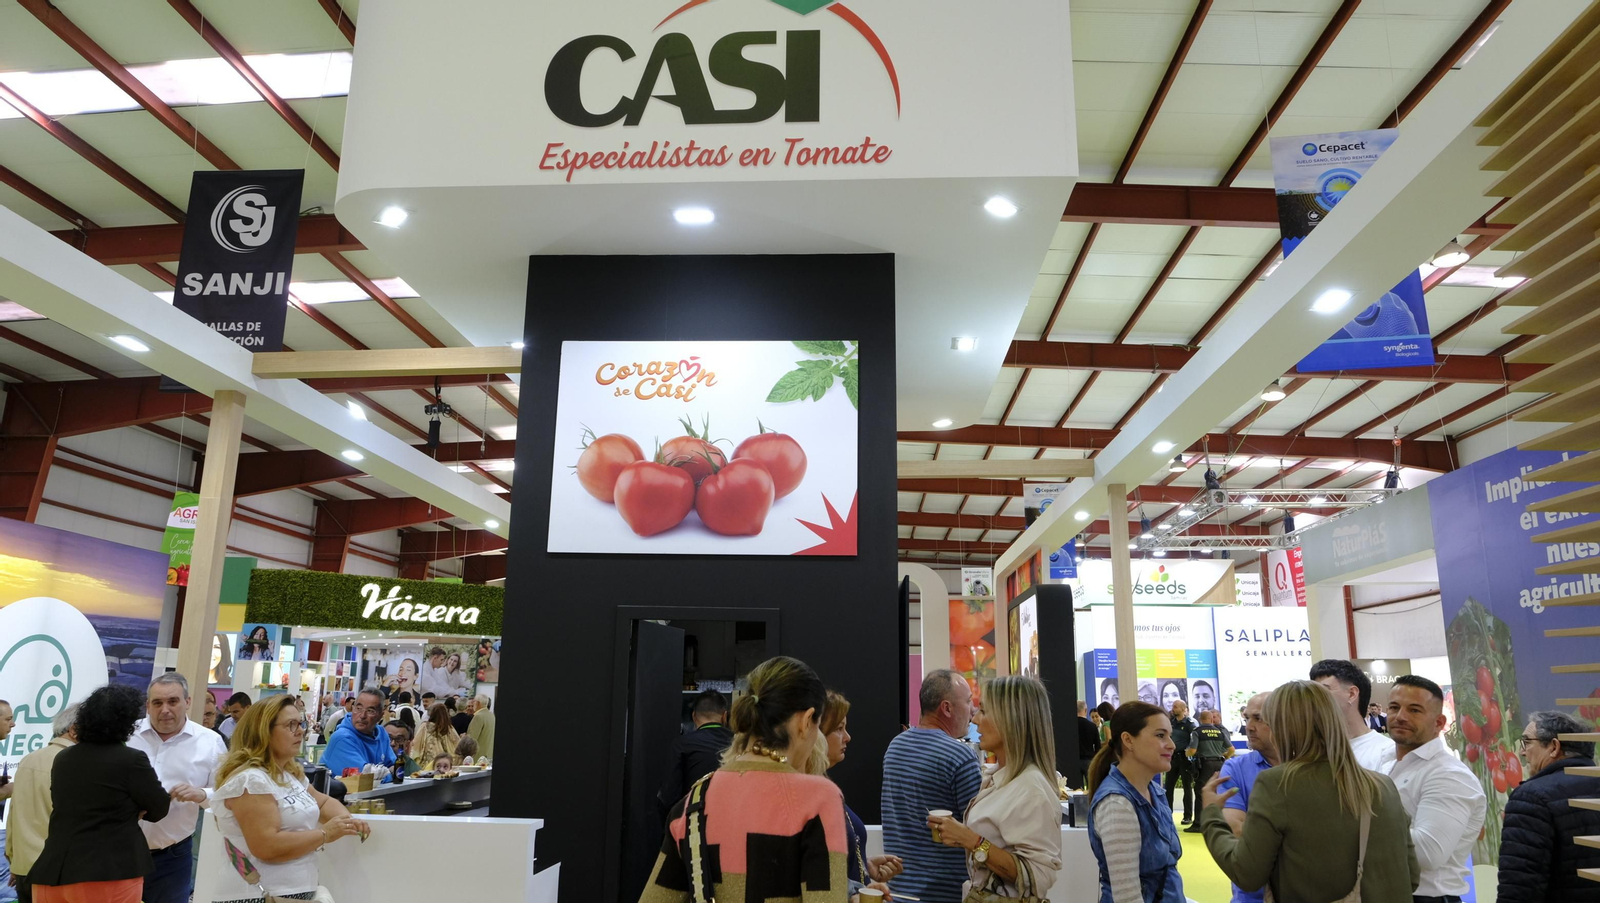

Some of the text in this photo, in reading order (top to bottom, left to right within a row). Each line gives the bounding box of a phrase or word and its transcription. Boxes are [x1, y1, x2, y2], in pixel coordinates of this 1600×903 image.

[544, 29, 821, 128] CASI
[1318, 141, 1366, 153] Cepacet
[538, 136, 893, 182] Especialistas en Tomate
[1352, 153, 1378, 161] RENTABLE
[182, 272, 285, 296] SANJI
[246, 322, 262, 331] DE
[1383, 342, 1420, 353] syngenta
[614, 377, 697, 402] de Casi
[1151, 624, 1164, 632] tus
[1165, 623, 1181, 634] ojos
